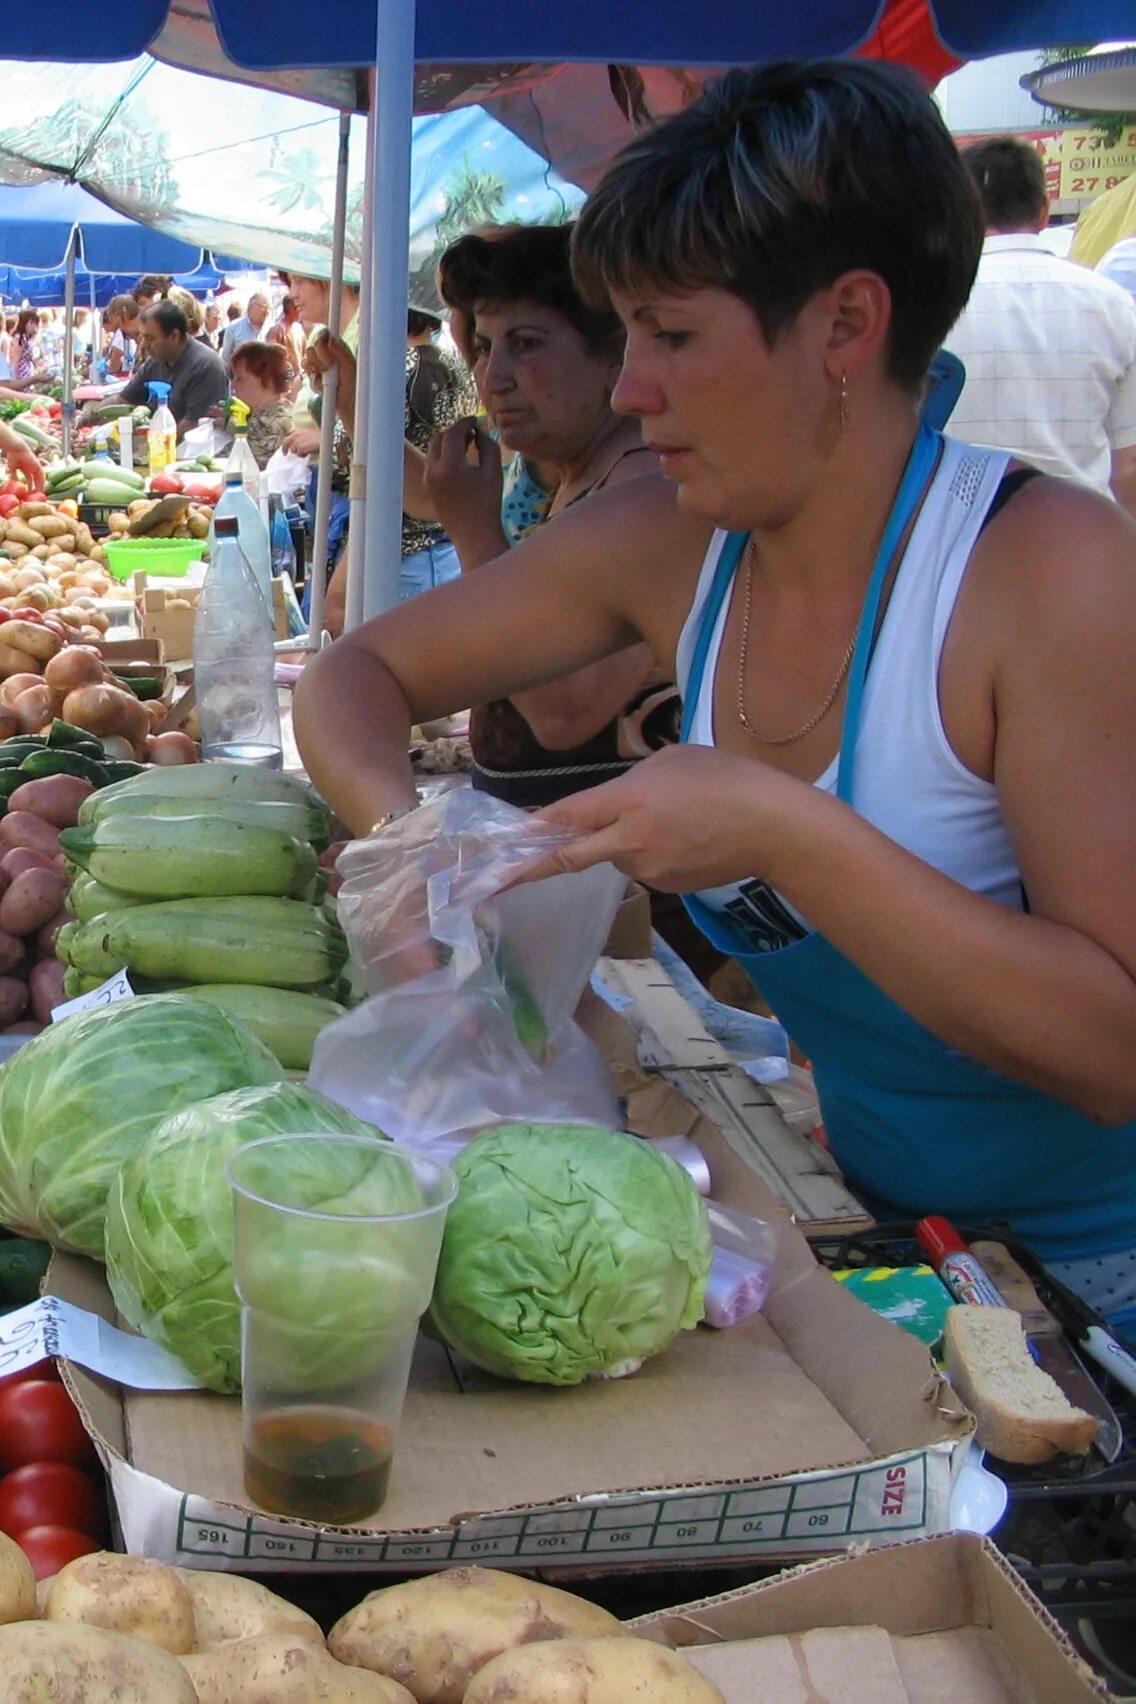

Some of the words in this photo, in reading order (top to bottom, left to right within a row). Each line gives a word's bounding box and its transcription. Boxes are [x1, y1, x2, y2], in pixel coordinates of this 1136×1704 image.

[1071, 178, 1100, 192] 27
[880, 1466, 906, 1516] SIZE
[808, 1514, 829, 1527] 60
[676, 1527, 697, 1539] 80
[742, 1521, 763, 1533] 70
[197, 1529, 230, 1544] 165
[537, 1537, 568, 1548] 100
[609, 1532, 632, 1543] 90
[264, 1540, 297, 1552] 150
[334, 1545, 366, 1556] 135
[401, 1546, 433, 1556] 120
[470, 1541, 500, 1552] 110
